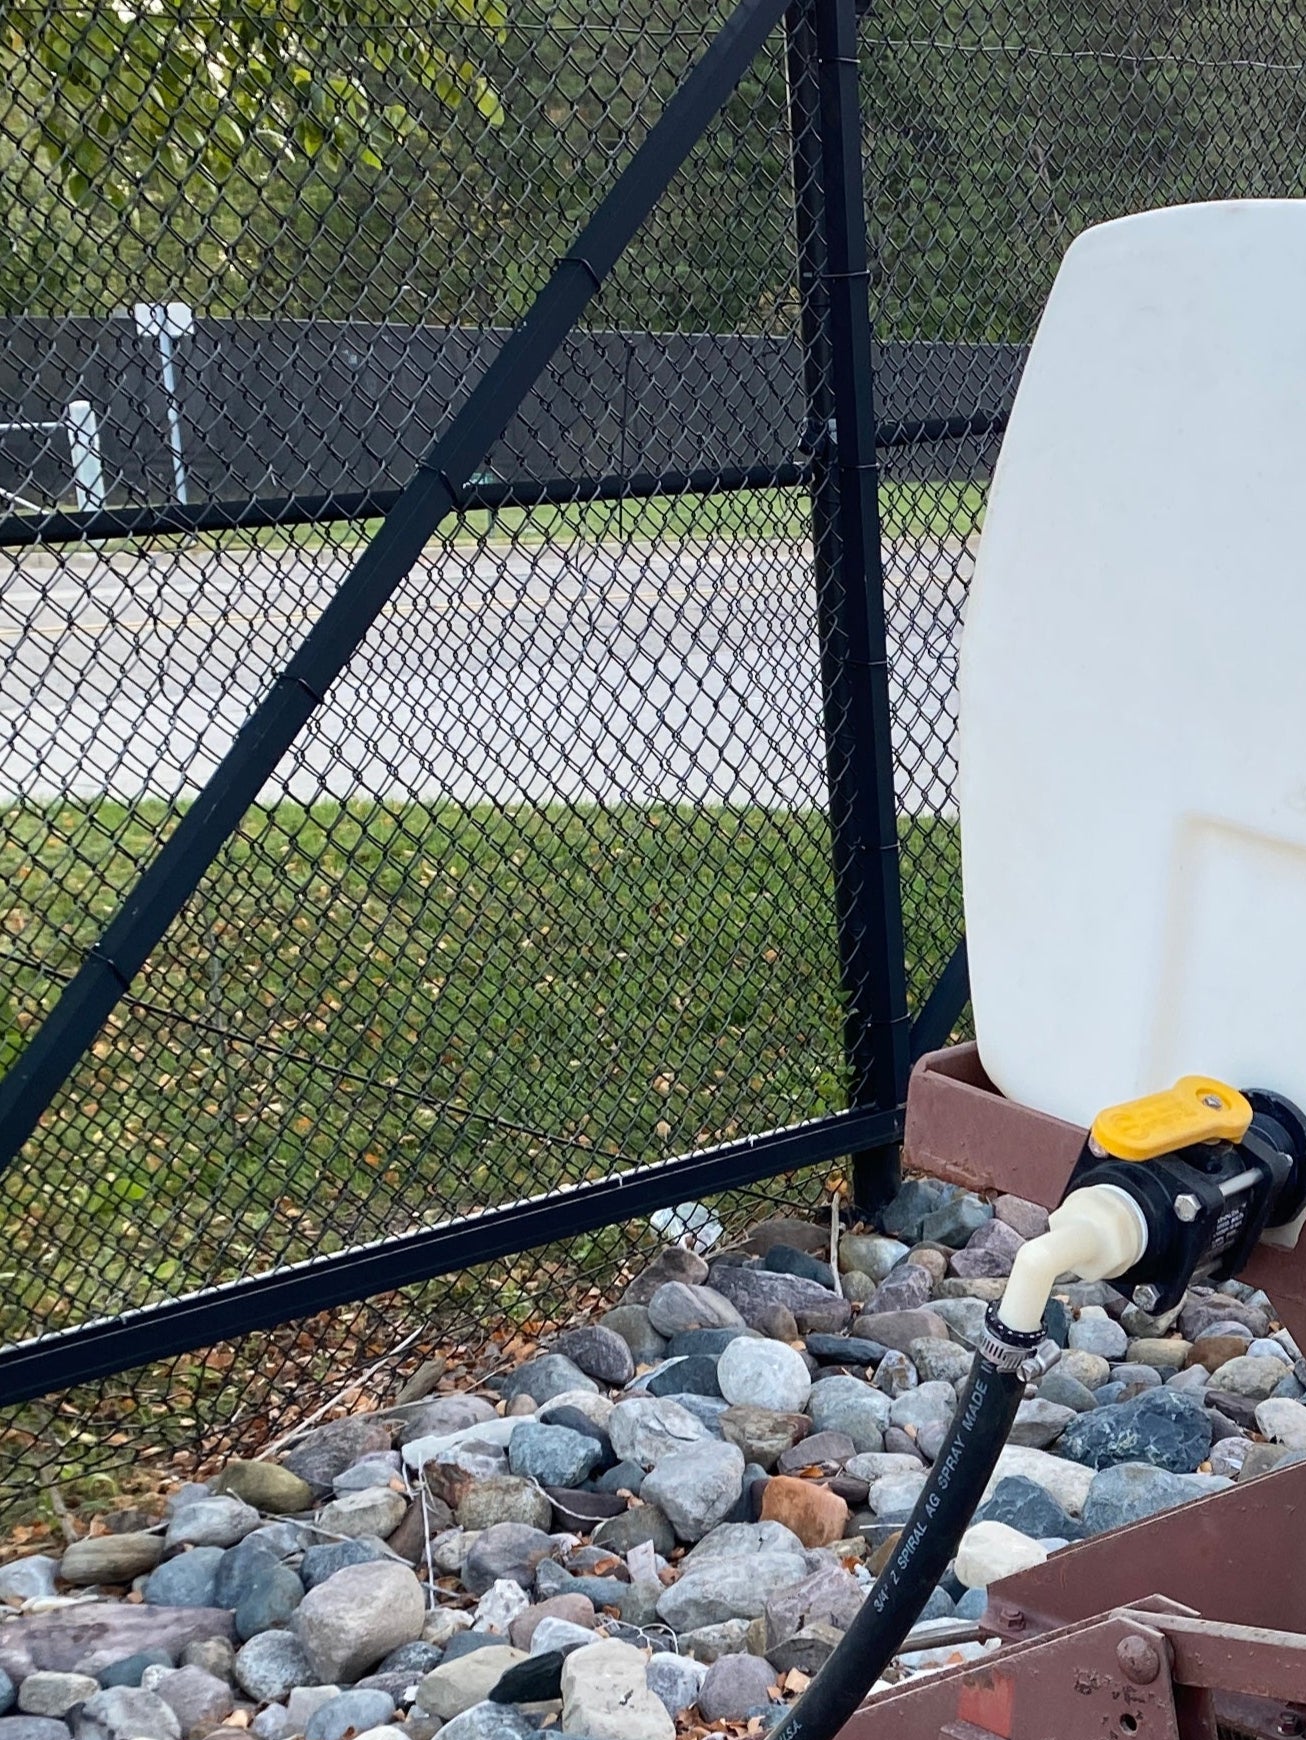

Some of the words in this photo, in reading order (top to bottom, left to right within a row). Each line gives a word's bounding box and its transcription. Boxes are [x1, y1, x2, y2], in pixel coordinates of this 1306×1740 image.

[898, 1522, 928, 1570] SPIRAL
[924, 1492, 942, 1522] AG
[938, 1434, 966, 1490] SPRAY
[962, 1378, 988, 1432] MADE
